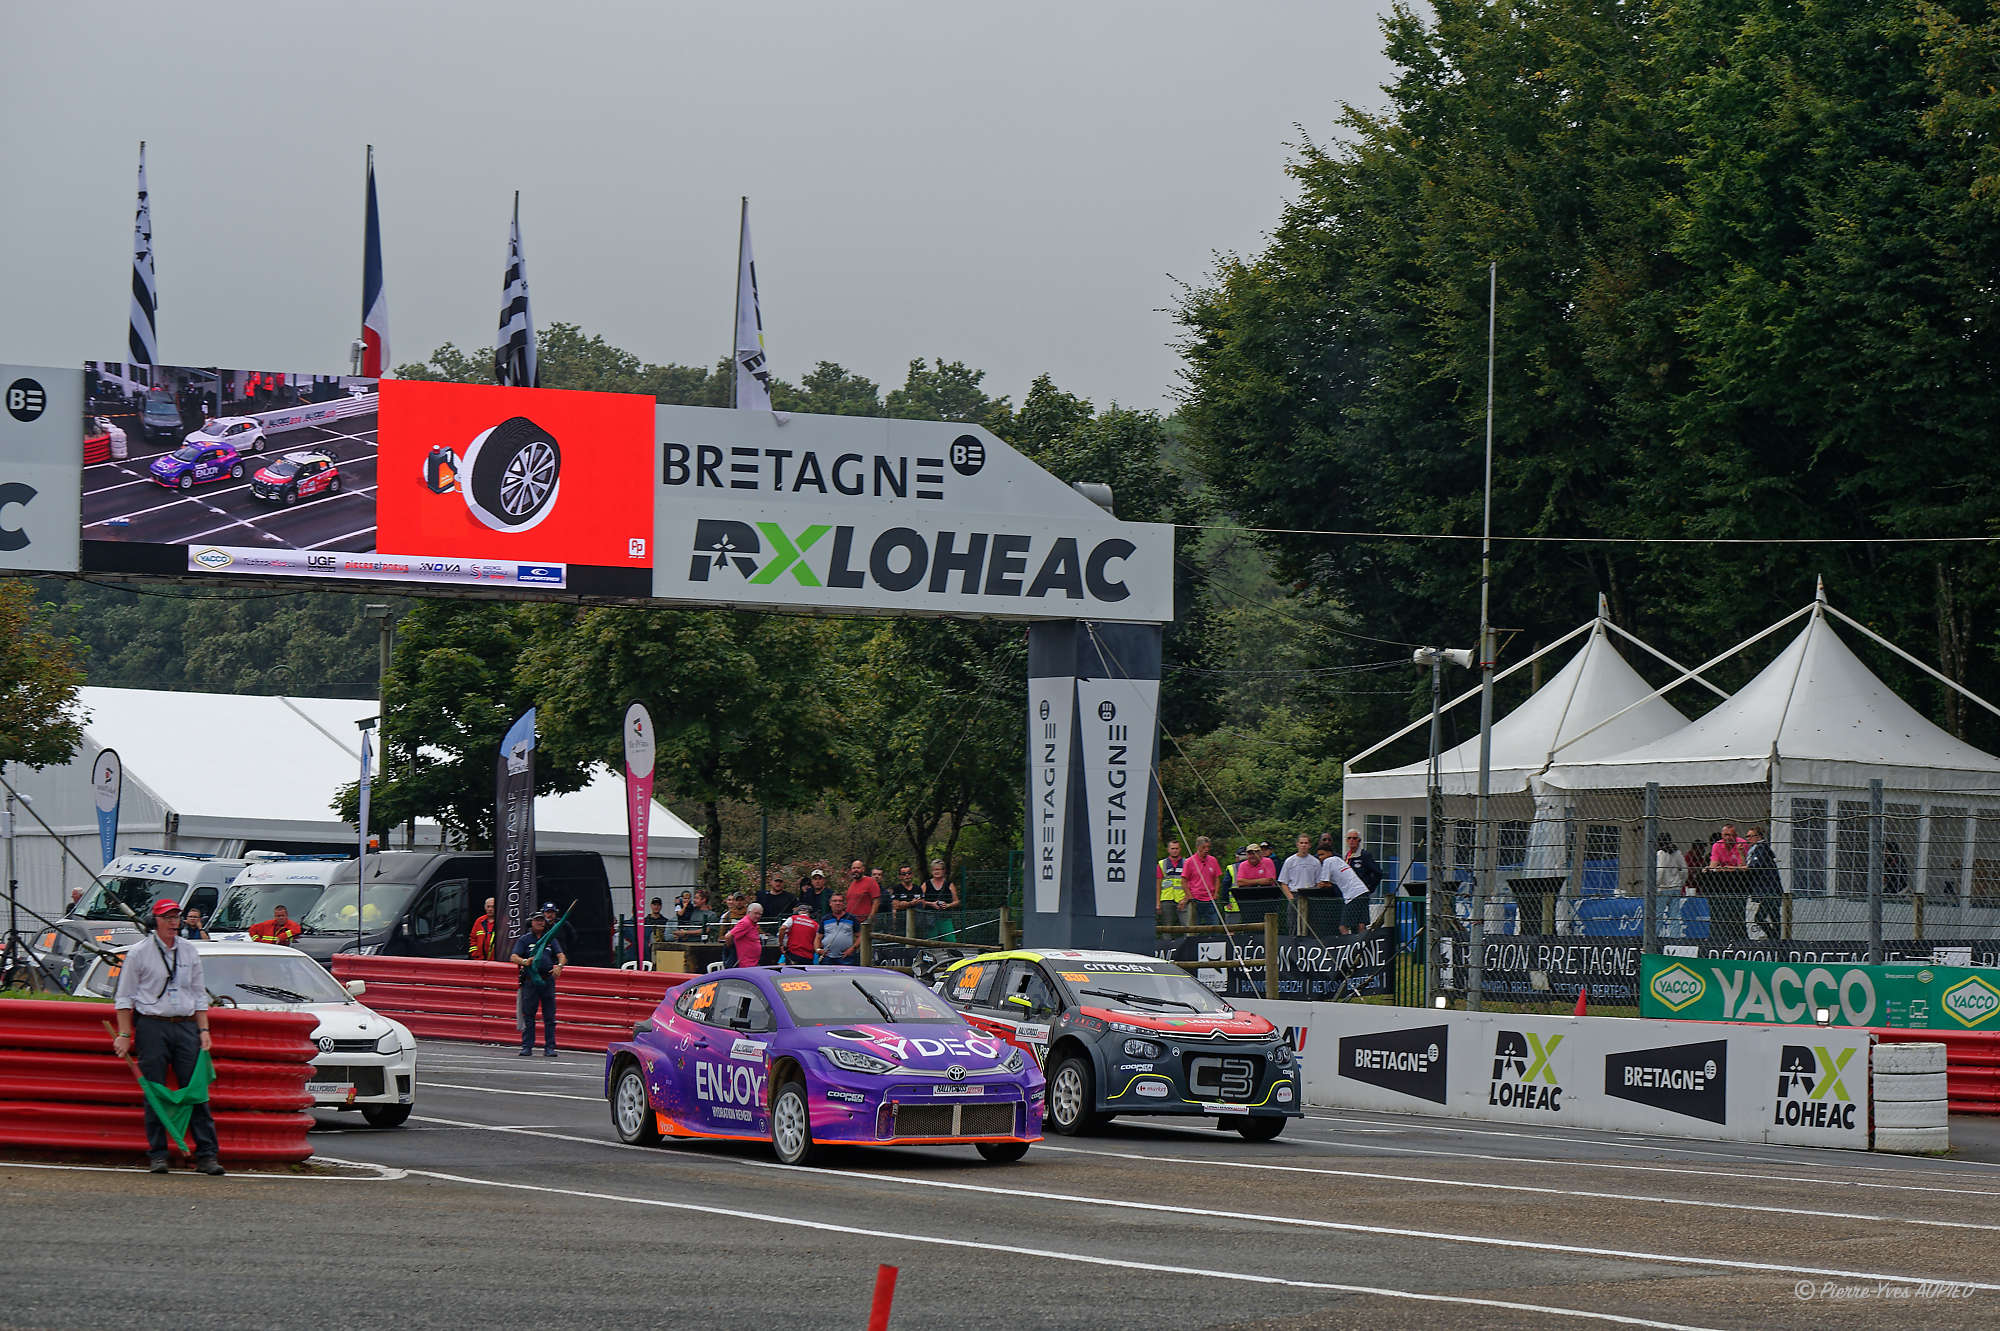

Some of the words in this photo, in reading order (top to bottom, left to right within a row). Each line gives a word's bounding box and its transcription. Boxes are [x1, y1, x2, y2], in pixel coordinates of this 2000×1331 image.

[662, 442, 945, 500] BRETAGNE
[200, 555, 228, 563] YACCO
[307, 556, 336, 566] UGF
[1042, 722, 1057, 881] BRETAGNE
[1106, 724, 1128, 883] BRETAGNE
[120, 863, 177, 877] ASSU
[1296, 938, 1386, 973] BRETAGNE
[1461, 943, 1530, 973] RGION
[1538, 945, 1639, 977] BRETAGNE
[780, 981, 813, 992] 335
[960, 965, 984, 989] 330
[1061, 973, 1091, 983] 330
[692, 980, 719, 1011] 335
[1658, 979, 1697, 996] YACCO
[1710, 966, 1877, 1027] YACCO
[1951, 994, 1995, 1010] YACCO
[879, 1038, 999, 1060] YDEO
[1354, 1048, 1428, 1073] BRETAGNE
[695, 1060, 761, 1108] ENJOY
[1623, 1065, 1705, 1092] BRETAGNE
[827, 1090, 865, 1099] COOPER
[1490, 1082, 1563, 1112] LOHEAC
[1774, 1099, 1857, 1130] LOHEAC
